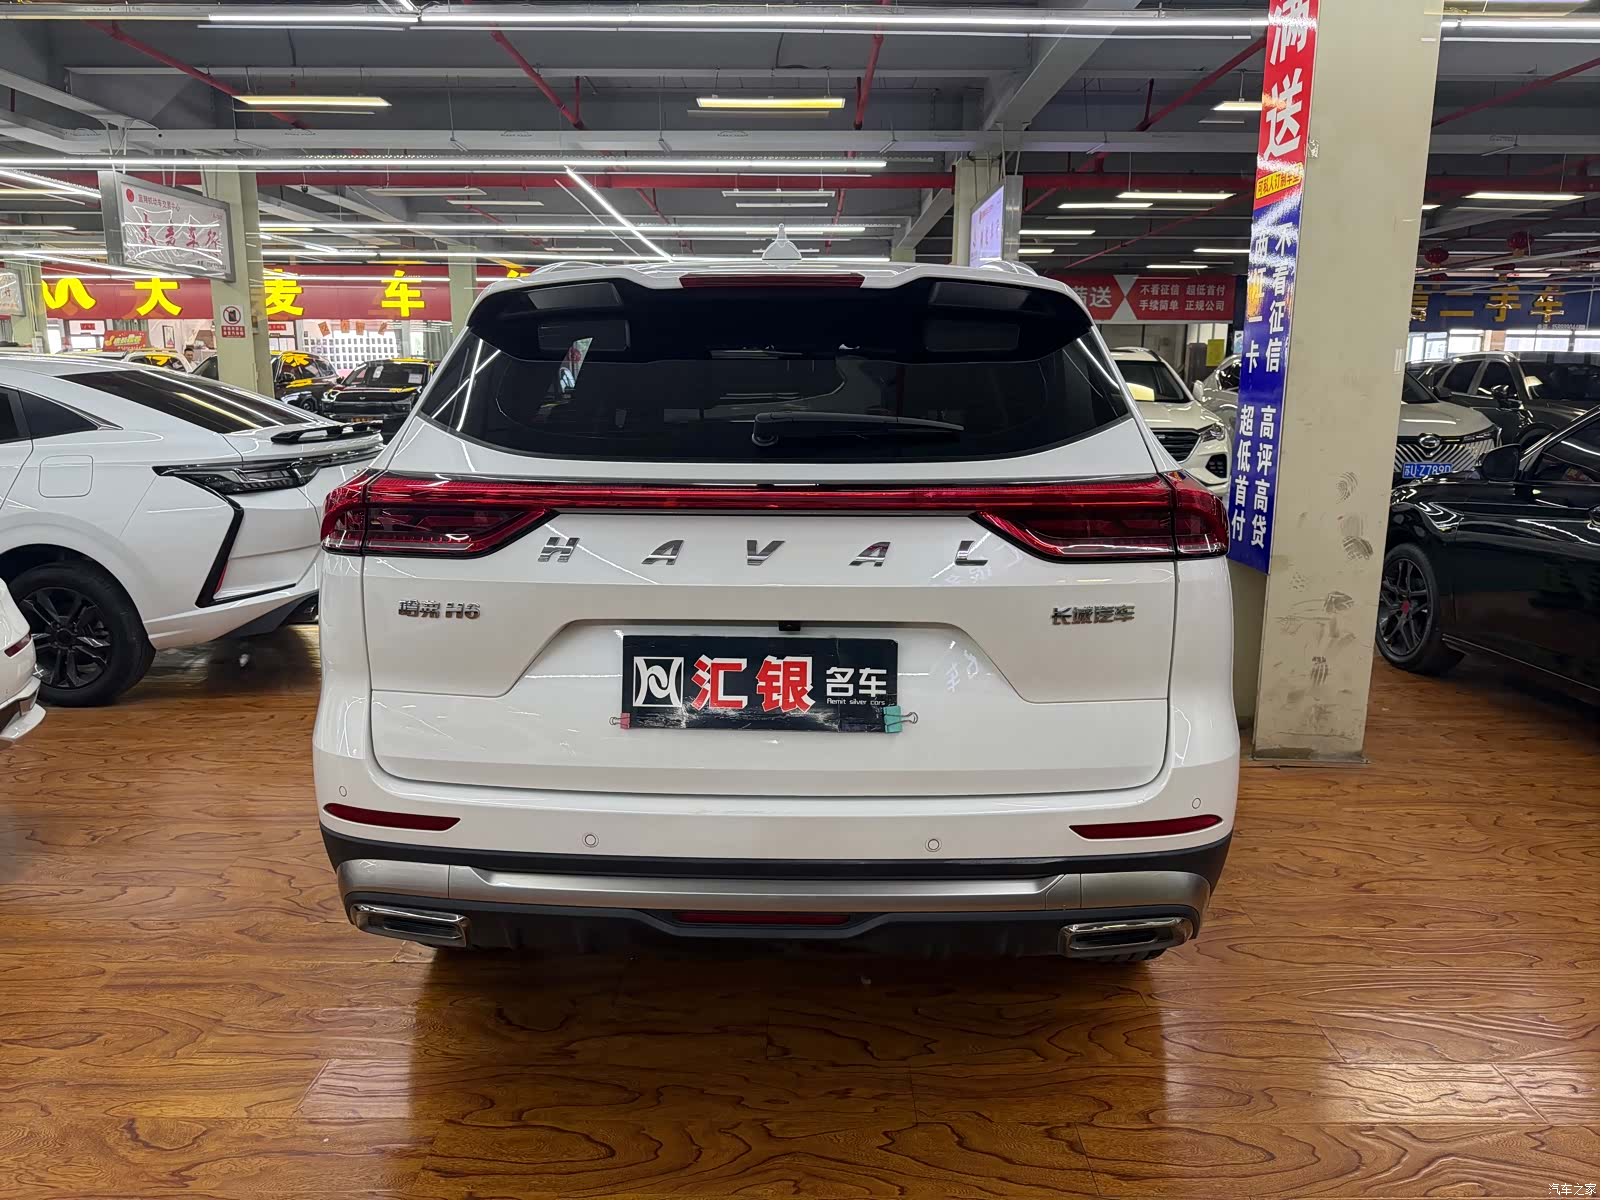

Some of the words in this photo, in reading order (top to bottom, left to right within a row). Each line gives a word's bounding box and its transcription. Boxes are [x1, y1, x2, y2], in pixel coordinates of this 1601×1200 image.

[1264, 0, 1310, 160] 满送
[1139, 300, 1179, 312] 手续简单
[1185, 300, 1225, 312] 正规公司
[1140, 285, 1180, 296] 不看征信
[1186, 285, 1225, 296] 超低首付
[1265, 222, 1293, 373] 不看征信
[1231, 404, 1255, 542] 超低首付
[1251, 405, 1277, 549] 高评高贷
[537, 536, 989, 567] HAVAL
[445, 602, 480, 619] H6
[1051, 605, 1135, 625] 长城汽车
[691, 654, 816, 713] 汇银
[826, 667, 887, 697] 名车
